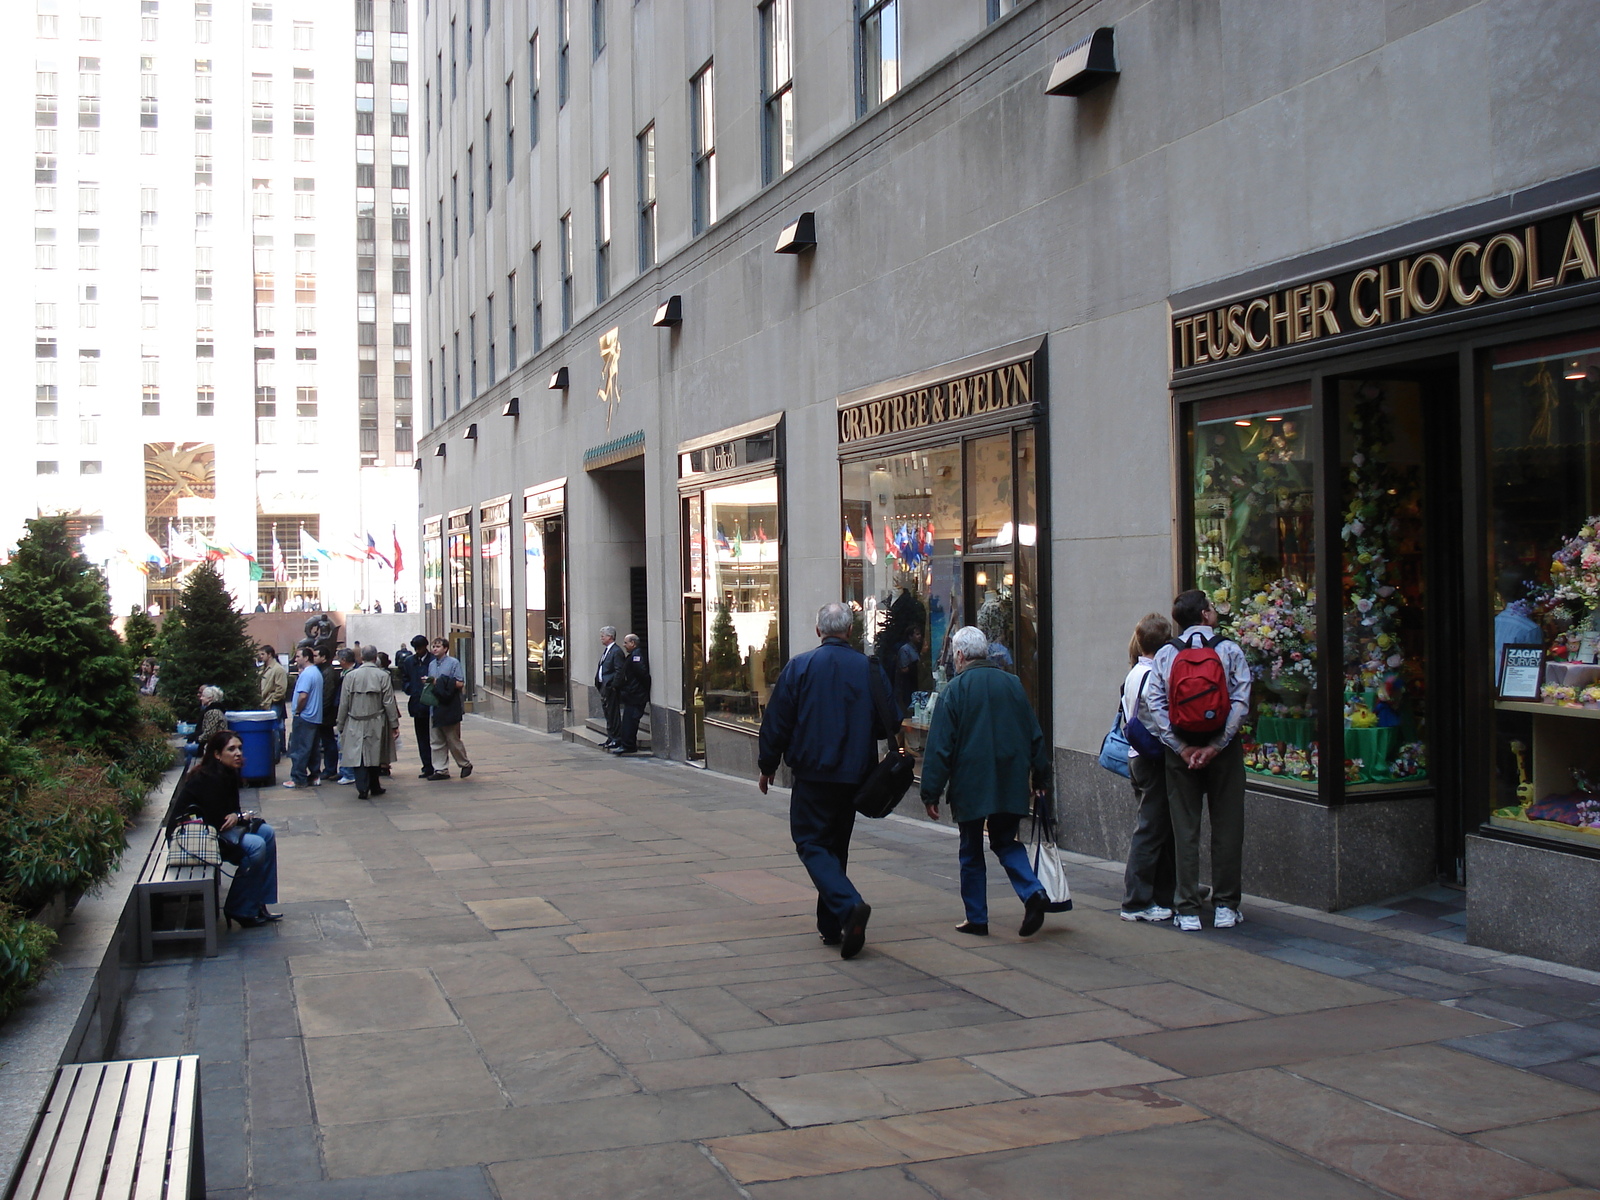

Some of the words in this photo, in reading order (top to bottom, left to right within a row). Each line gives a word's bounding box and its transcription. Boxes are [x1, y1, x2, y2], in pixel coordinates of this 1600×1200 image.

[1175, 280, 1341, 366] TEUSCHER
[841, 389, 929, 442] CRABTREE
[932, 386, 945, 423] &
[948, 362, 1030, 420] EVELYN
[1507, 657, 1541, 666] SURVEY
[1508, 649, 1542, 658] ZAGAT
